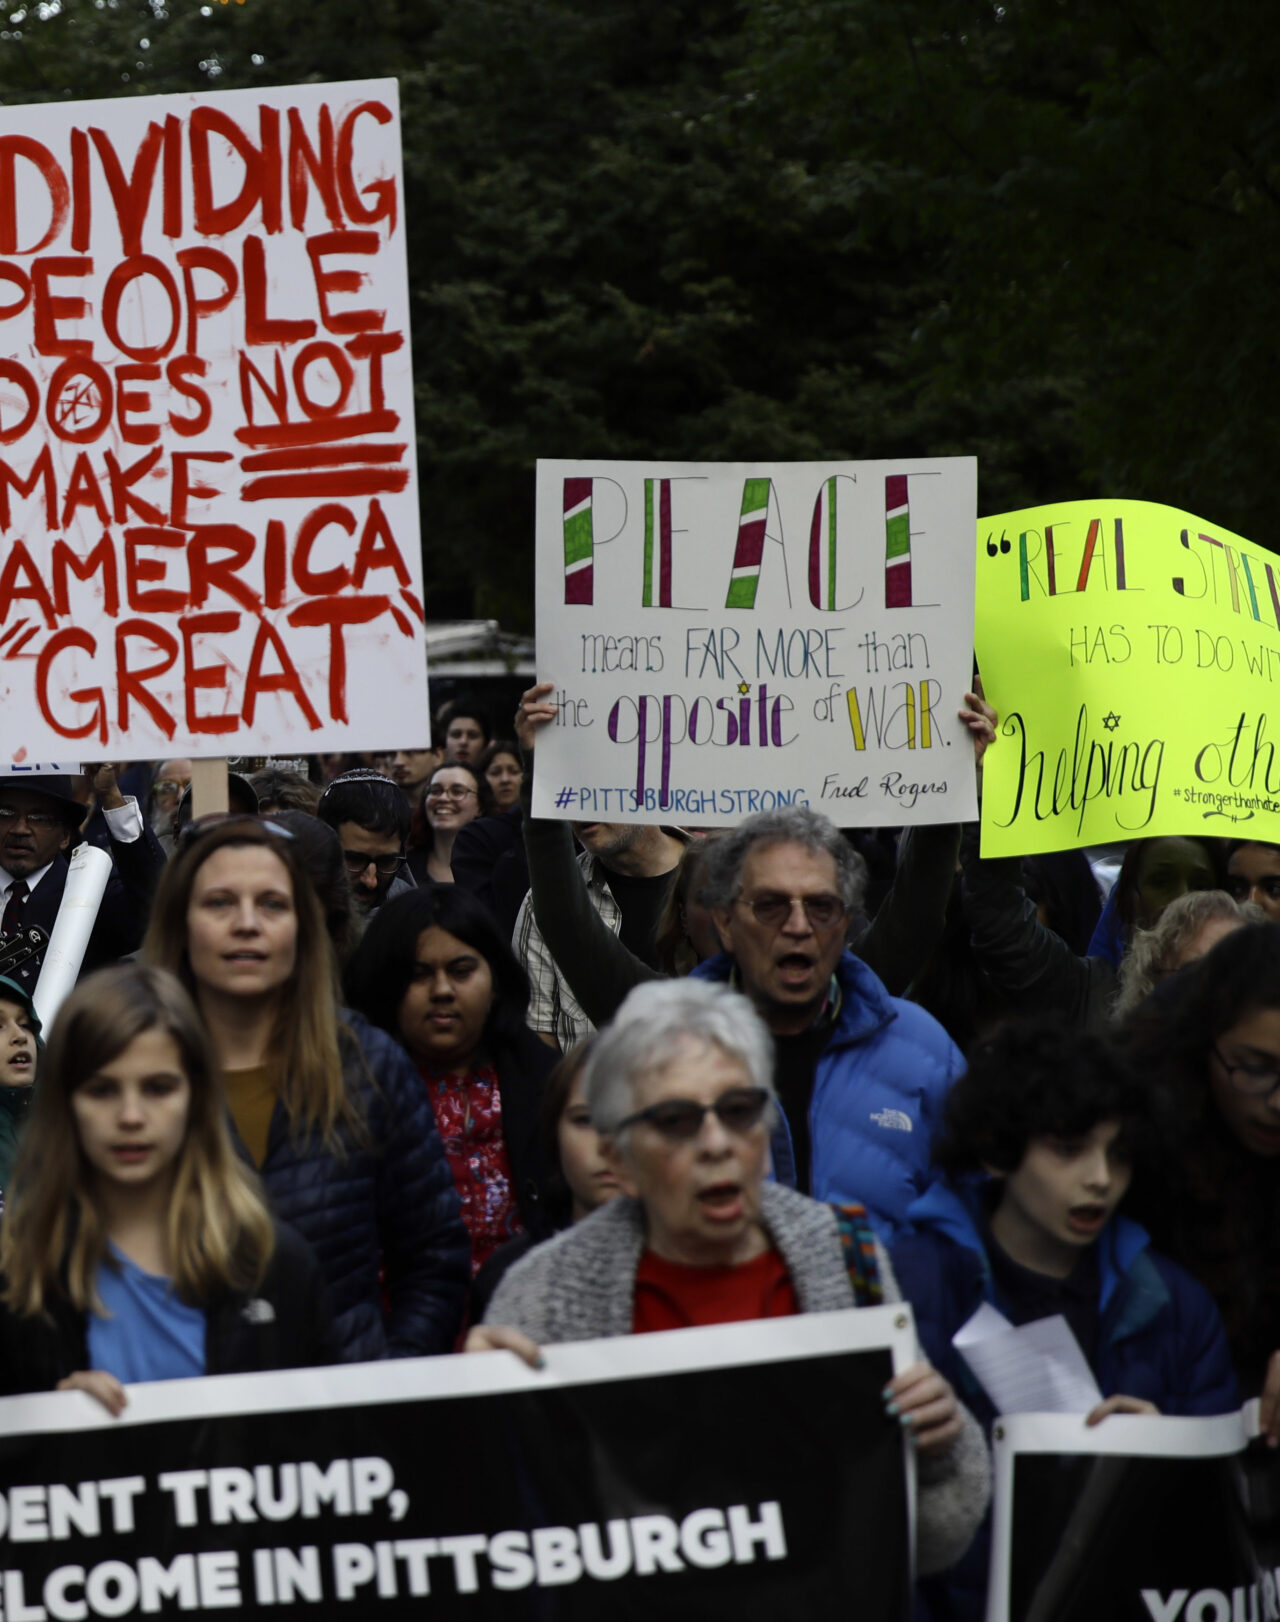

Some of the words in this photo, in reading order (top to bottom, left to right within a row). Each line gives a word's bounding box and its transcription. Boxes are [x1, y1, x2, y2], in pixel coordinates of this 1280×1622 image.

[238, 330, 405, 430] NOT
[563, 472, 942, 611] PEACE
[581, 633, 664, 673] means
[684, 628, 746, 679] FAR
[756, 628, 847, 679] MORE
[858, 631, 931, 673] than
[1070, 624, 1132, 667] HAS
[1147, 624, 1184, 664] TO
[1195, 629, 1234, 672] DO
[553, 690, 595, 728] the
[607, 679, 800, 807] opposite
[814, 682, 842, 722] of
[820, 771, 868, 800] Fred
[879, 771, 949, 809] Rogers
[992, 703, 1166, 837] helping
[158, 1456, 410, 1528] TRUMP,
[253, 1545, 323, 1606] IN
[332, 1500, 788, 1600] PITTSBURGH
